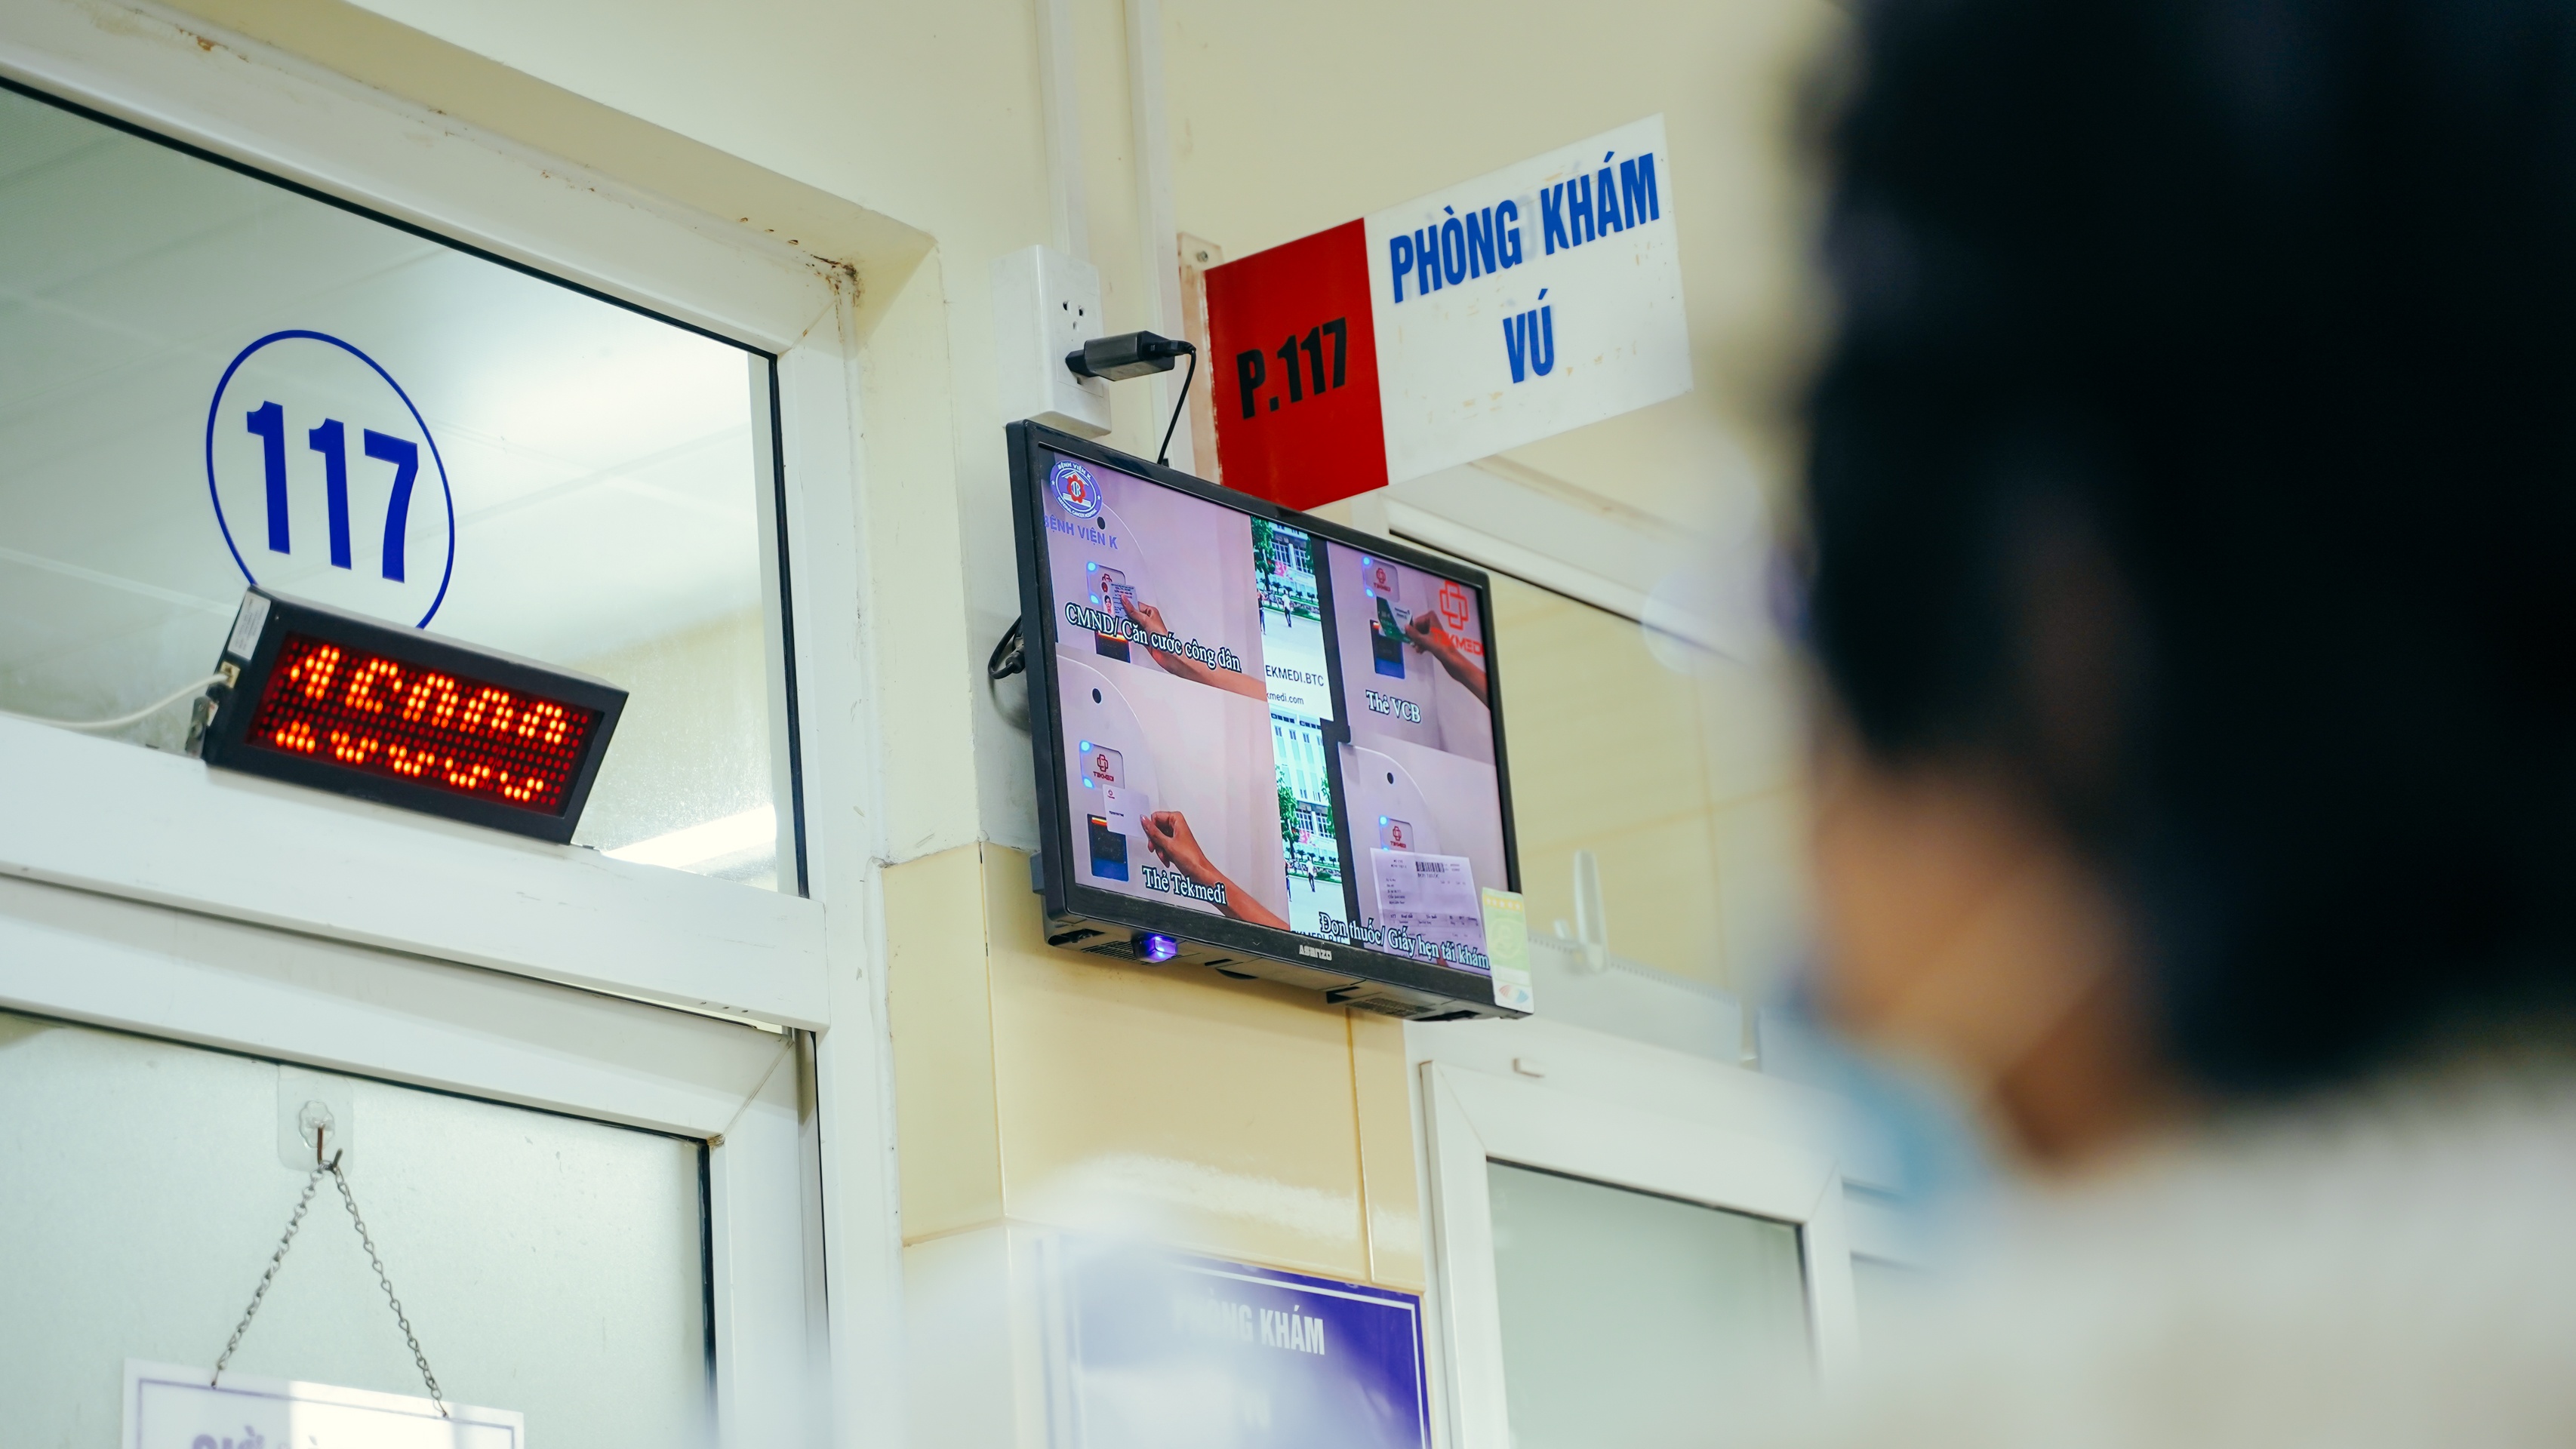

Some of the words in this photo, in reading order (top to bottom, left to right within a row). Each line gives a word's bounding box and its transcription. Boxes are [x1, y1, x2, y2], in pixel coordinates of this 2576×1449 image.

[1389, 199, 1523, 304] PHÒNG
[1540, 150, 1660, 256] KHÁM
[1502, 288, 1556, 384] VÚ
[1236, 315, 1347, 420] P.117
[246, 400, 419, 584] 117
[1045, 514, 1074, 536] BỆNH
[1077, 525, 1106, 545] VIỆN
[1109, 535, 1118, 549] K
[1122, 620, 1149, 645] Căn
[1151, 632, 1182, 654] cước
[1185, 639, 1216, 669] công
[1218, 648, 1242, 672] dân
[1365, 690, 1390, 715] Thẻ
[1390, 697, 1421, 723] VCB
[1142, 866, 1169, 892] Thẻ
[1170, 873, 1226, 905] Tekmedi
[1387, 926, 1416, 958] Giấy
[1417, 934, 1440, 960] hẹn
[1441, 941, 1457, 962] tái
[1457, 944, 1490, 971] khám
[1171, 1287, 1254, 1343] ÒNG
[1260, 1303, 1325, 1356] KHÁM
